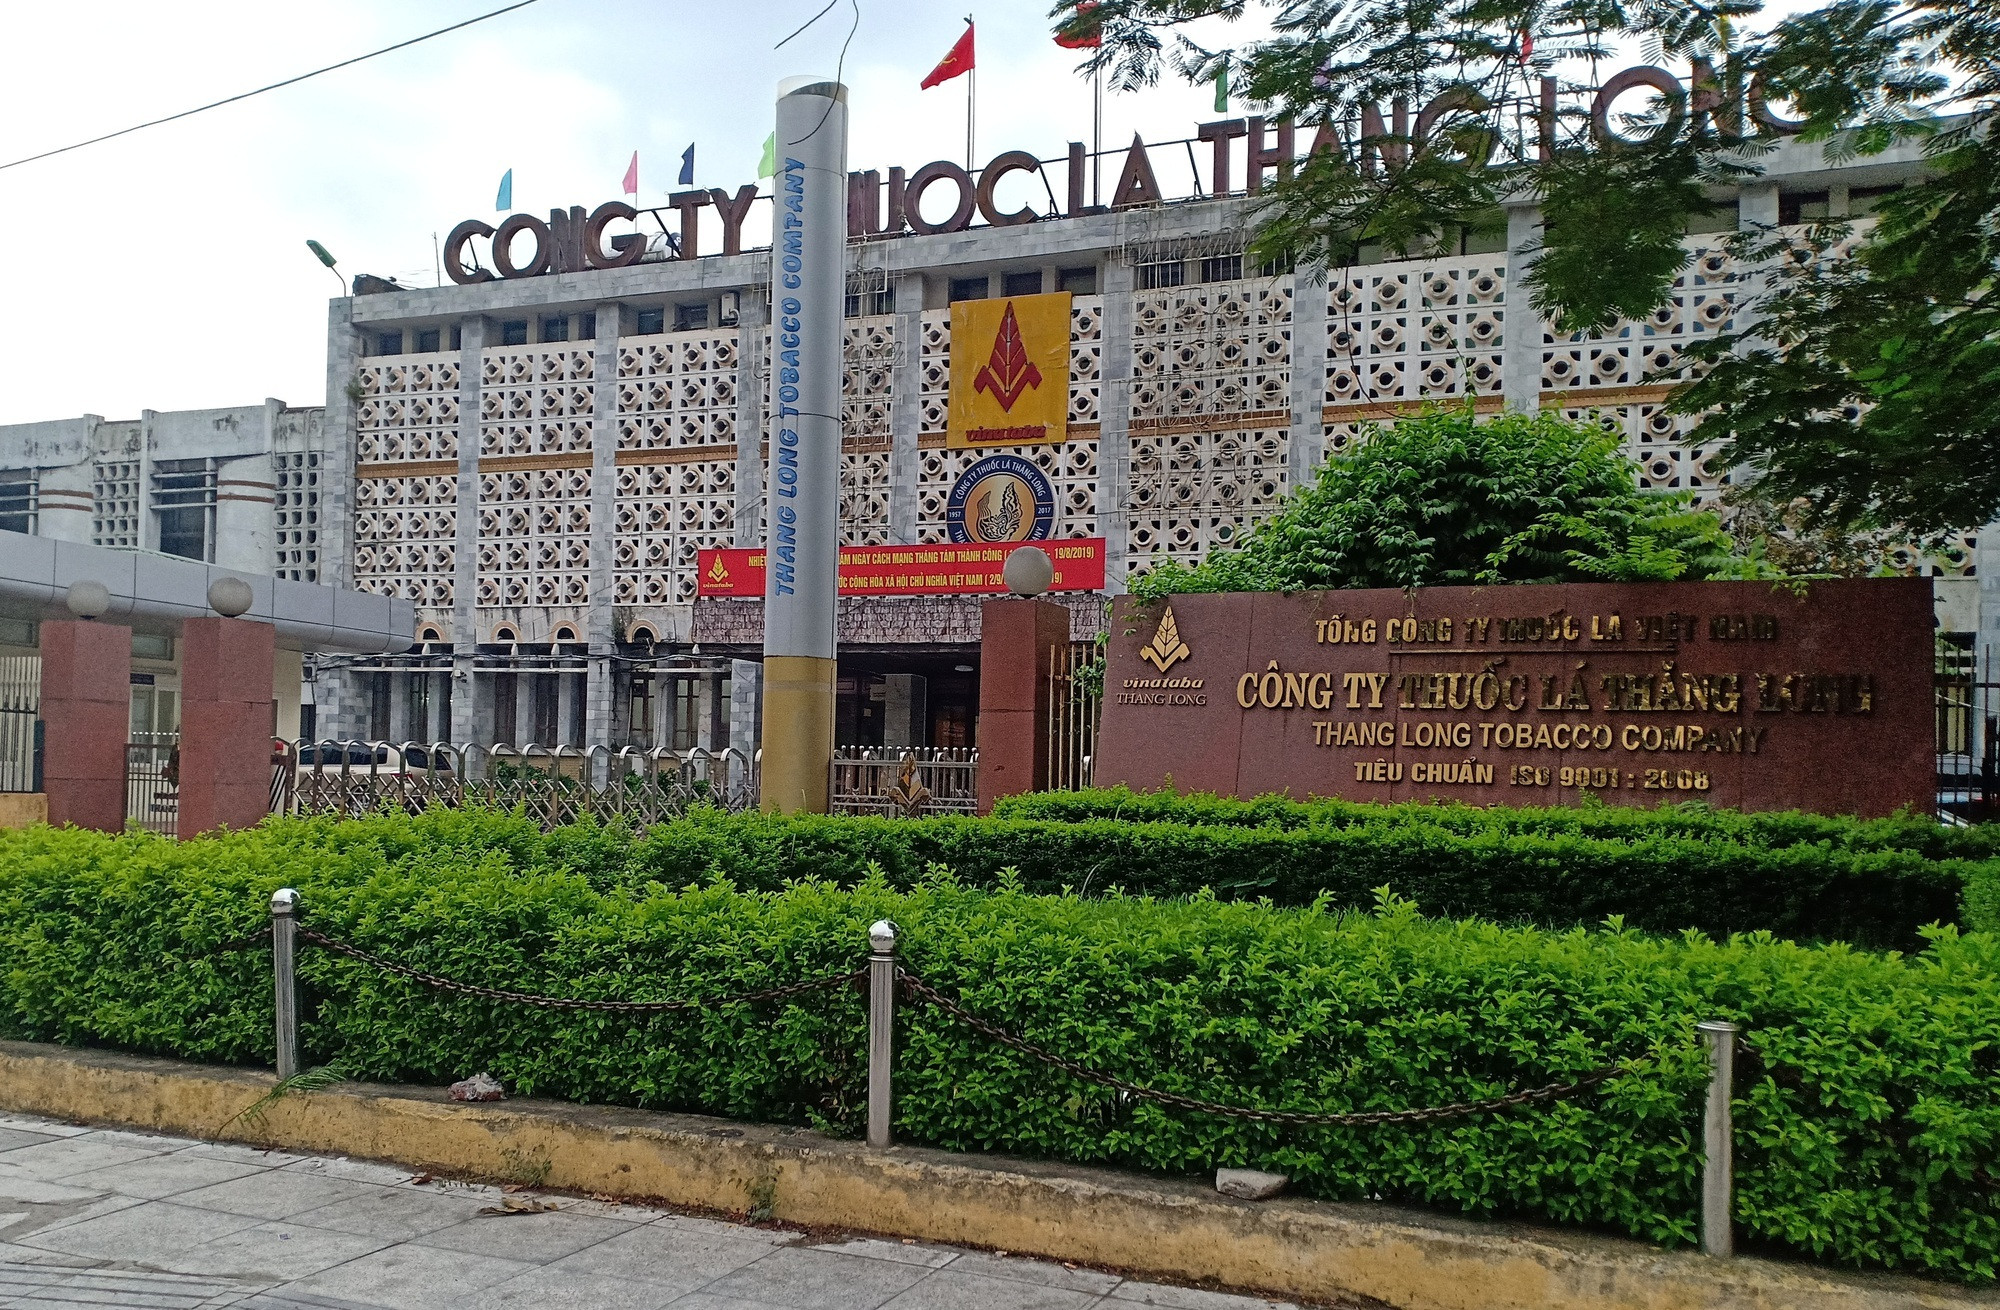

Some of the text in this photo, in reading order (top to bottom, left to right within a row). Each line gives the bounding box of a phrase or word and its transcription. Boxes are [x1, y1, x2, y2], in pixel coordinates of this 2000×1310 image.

[668, 184, 760, 261] TY
[1068, 131, 1164, 218] LA
[775, 156, 806, 597] THANG LONG TOBACCO COMPANY
[968, 470, 978, 482] TY
[1031, 475, 1046, 498] LONG
[1037, 506, 1051, 515] 2017
[872, 550, 891, 565] CÁCH
[892, 551, 914, 567] MẠNG
[915, 549, 939, 564] THÁNG
[940, 549, 956, 563] TÁM
[957, 548, 981, 563] THÀNH
[982, 547, 1003, 562] CÔNG
[849, 574, 869, 590] CỘNG
[949, 572, 965, 588] VIỆT
[965, 573, 983, 586] NAM
[1386, 612, 1453, 643] CÔNG
[1463, 616, 1491, 642] TY
[1122, 676, 1205, 689] vinataba
[1236, 659, 1334, 709] CÔNG
[1342, 672, 1390, 709] TY
[1397, 654, 1528, 711] THUỐC
[1537, 659, 1590, 710] LÁ
[1600, 660, 1741, 712] THĂNG
[1116, 692, 1207, 706] THANG LONG
[1312, 721, 1765, 753] THANG LONG TOBACCO COMPANY
[1354, 757, 1403, 783] TIÊU
[1411, 756, 1494, 784] CHUẨN
[1509, 764, 1550, 786] ISO
[1559, 766, 1619, 788] 9001
[1643, 768, 1710, 790] 2008
